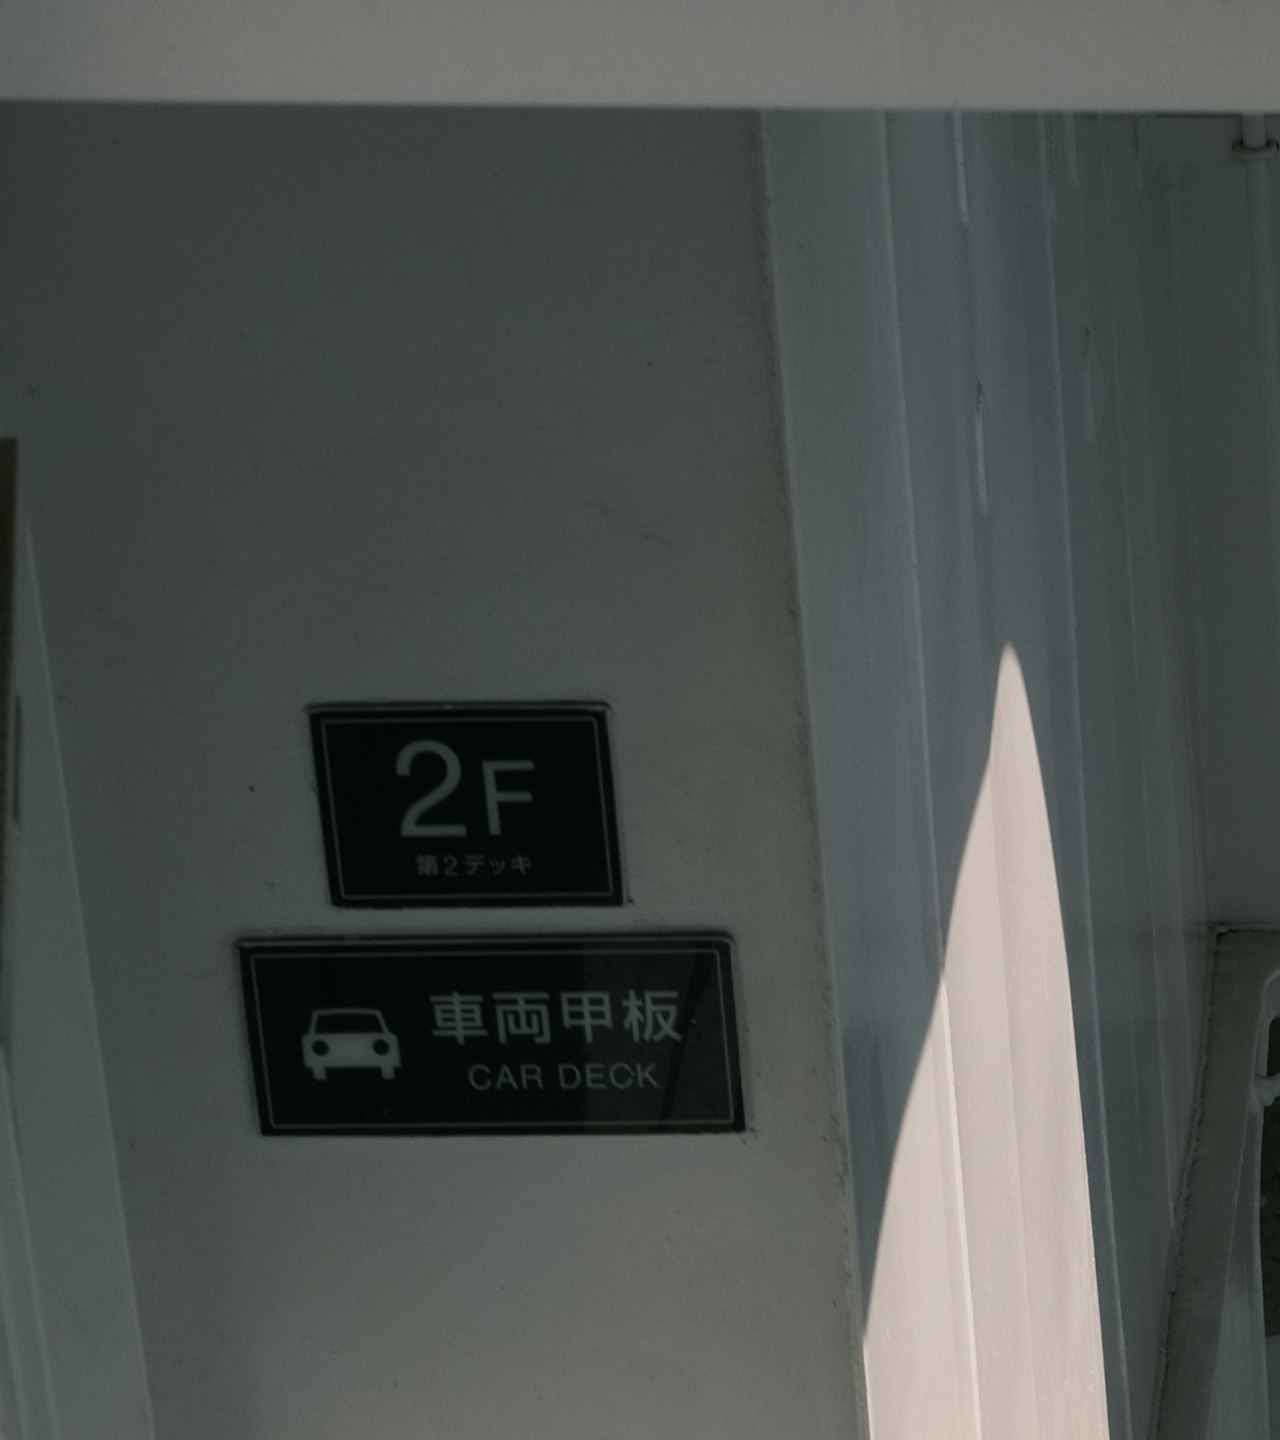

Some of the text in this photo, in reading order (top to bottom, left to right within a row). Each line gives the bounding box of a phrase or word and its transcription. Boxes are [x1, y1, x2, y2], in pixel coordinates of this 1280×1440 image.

[396, 739, 535, 838] 2F
[416, 853, 533, 878] 第2デッキ
[428, 990, 683, 1045] 車両甲板
[467, 1061, 660, 1091] CAR DECK
